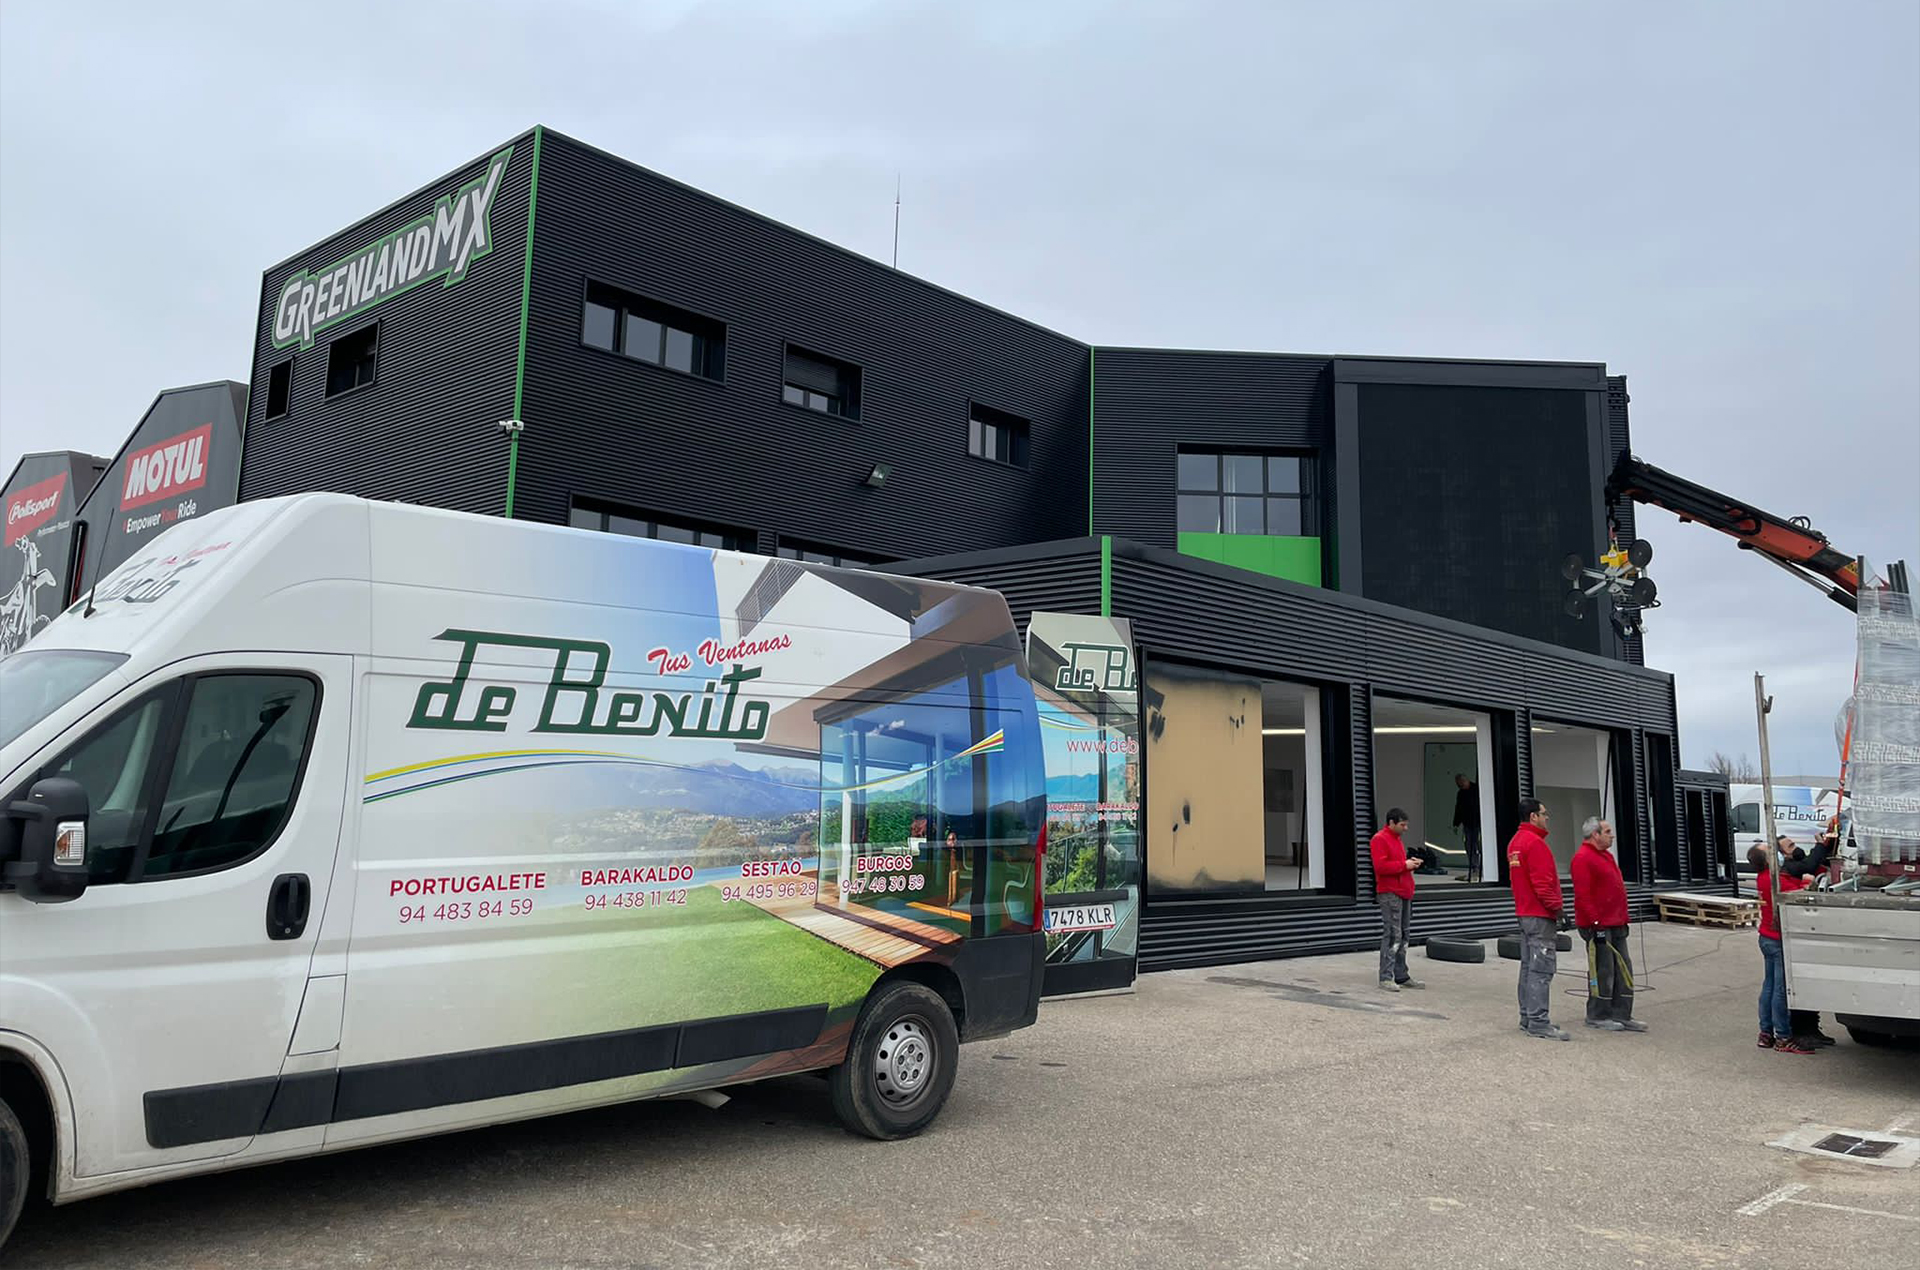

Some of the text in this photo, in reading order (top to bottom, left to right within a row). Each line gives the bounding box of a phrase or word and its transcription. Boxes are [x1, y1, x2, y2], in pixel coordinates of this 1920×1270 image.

[275, 162, 502, 341] GREENLANDMX
[124, 435, 204, 500] MOTUL
[648, 634, 792, 676] Tus Ventanas
[1055, 643, 1094, 691] de
[406, 628, 771, 740] de Benito
[1787, 805, 1827, 821] Benito
[742, 861, 801, 877] SESTAO
[858, 856, 912, 872] BURGOS
[390, 873, 546, 896] PORTUGALETE
[581, 866, 693, 886] BARAKALDO
[842, 875, 925, 893] 947 48 30 59
[585, 889, 687, 910] 94 438 11 42
[722, 881, 816, 901] 94 495 96 29
[400, 898, 532, 923] 94 483 84 59
[1051, 910, 1084, 926] 7478
[1088, 907, 1112, 924] KLR
